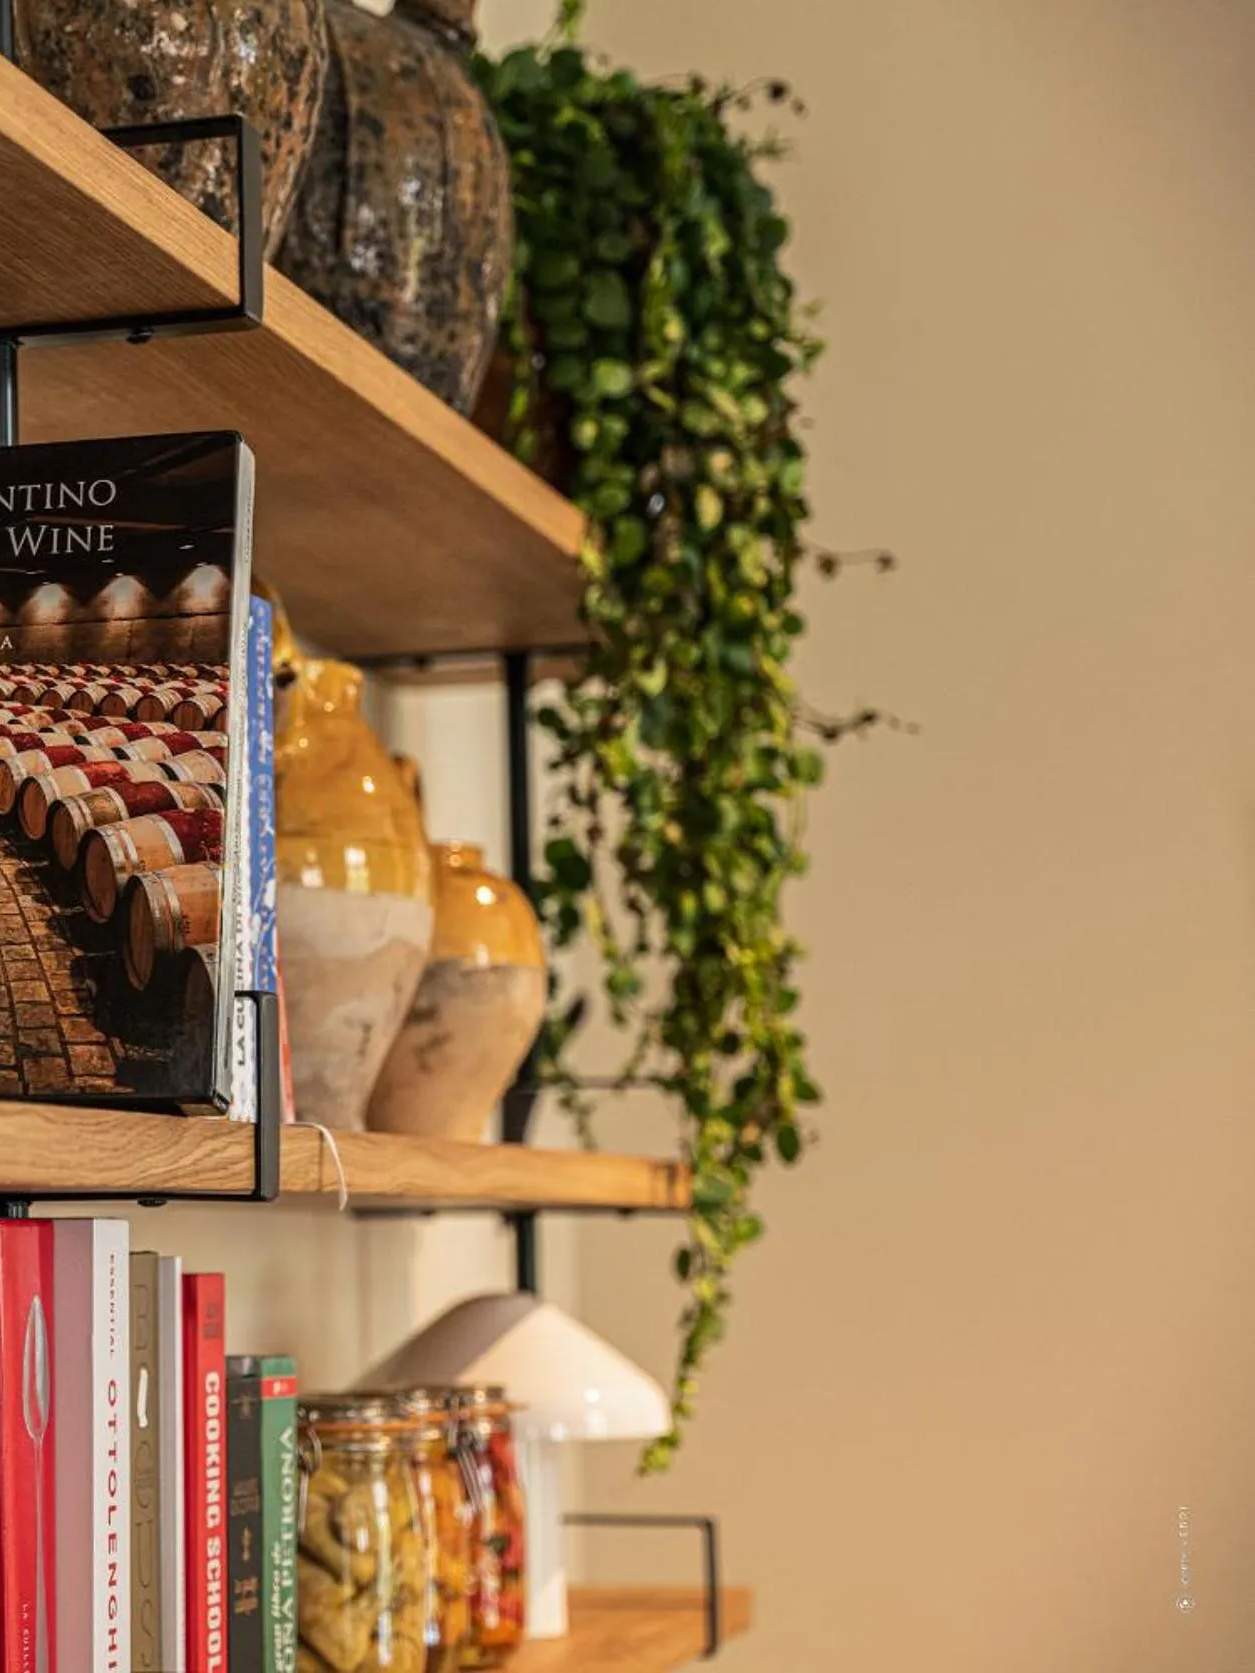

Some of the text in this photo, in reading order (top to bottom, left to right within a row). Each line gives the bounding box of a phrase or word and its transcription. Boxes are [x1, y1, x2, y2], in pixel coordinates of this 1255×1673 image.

[6, 524, 115, 557] WINE
[108, 1380, 118, 1669] OTTOLENGHI
[205, 1371, 222, 1672] COOKING SCHOOL
